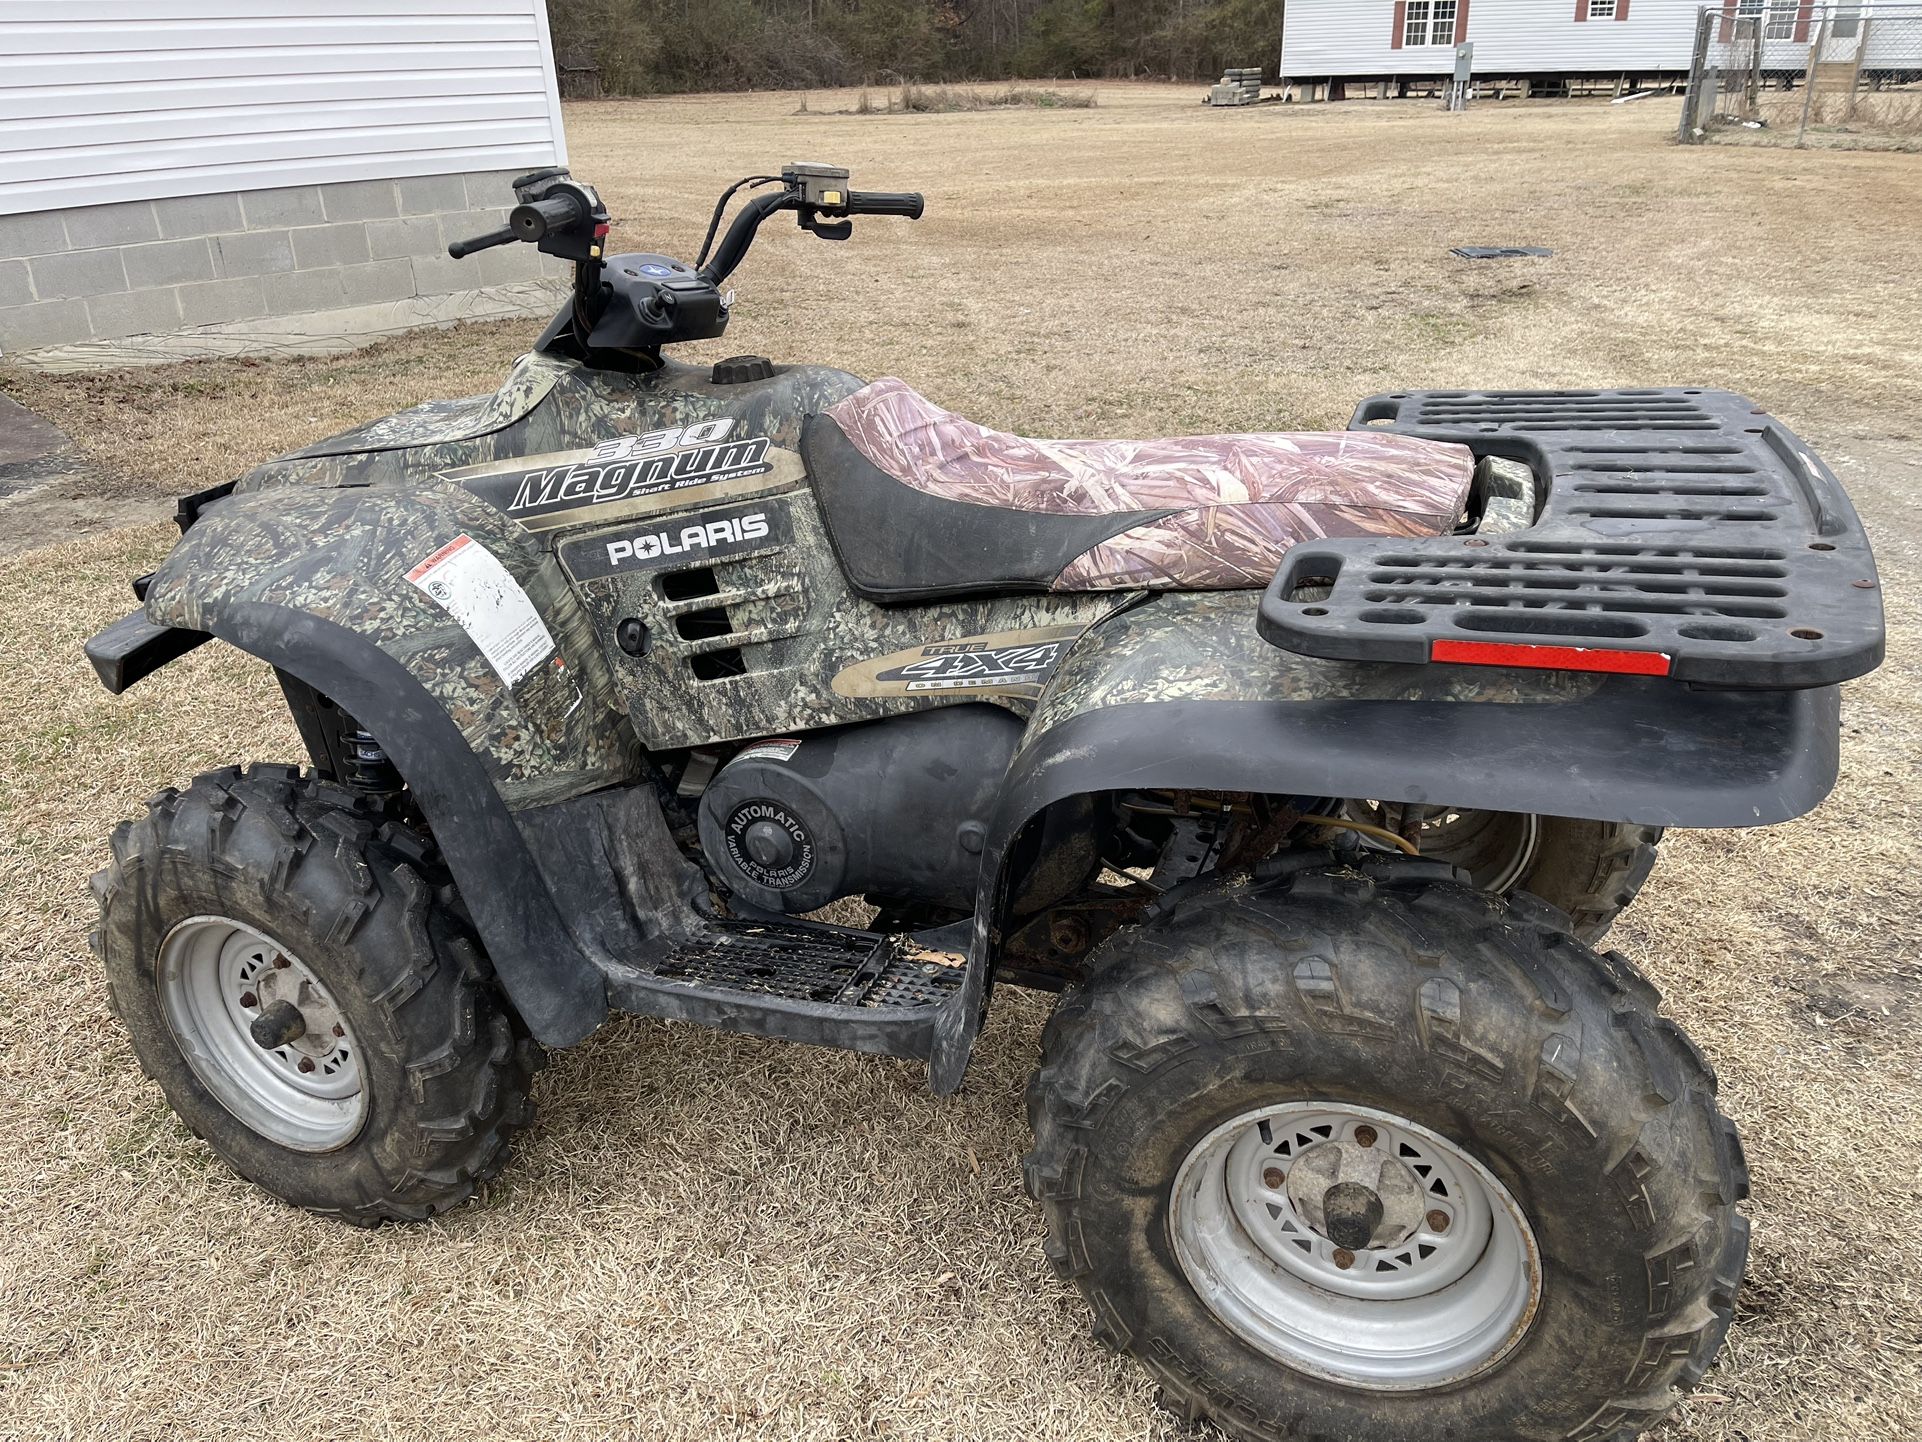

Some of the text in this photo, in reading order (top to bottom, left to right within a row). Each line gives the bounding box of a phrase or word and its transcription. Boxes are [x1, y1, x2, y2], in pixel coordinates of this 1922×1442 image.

[587, 418, 735, 465] 330
[507, 437, 770, 511] Magnum
[632, 467, 766, 497] Shaft Ride System
[606, 513, 769, 566] POLARIS
[926, 642, 986, 655] TRUE
[953, 674, 1036, 687] DEMAND
[731, 805, 805, 841] AUTOMATIC
[727, 835, 812, 886] VARIABLE TRANSMISSION
[749, 861, 795, 877] POLARIS
